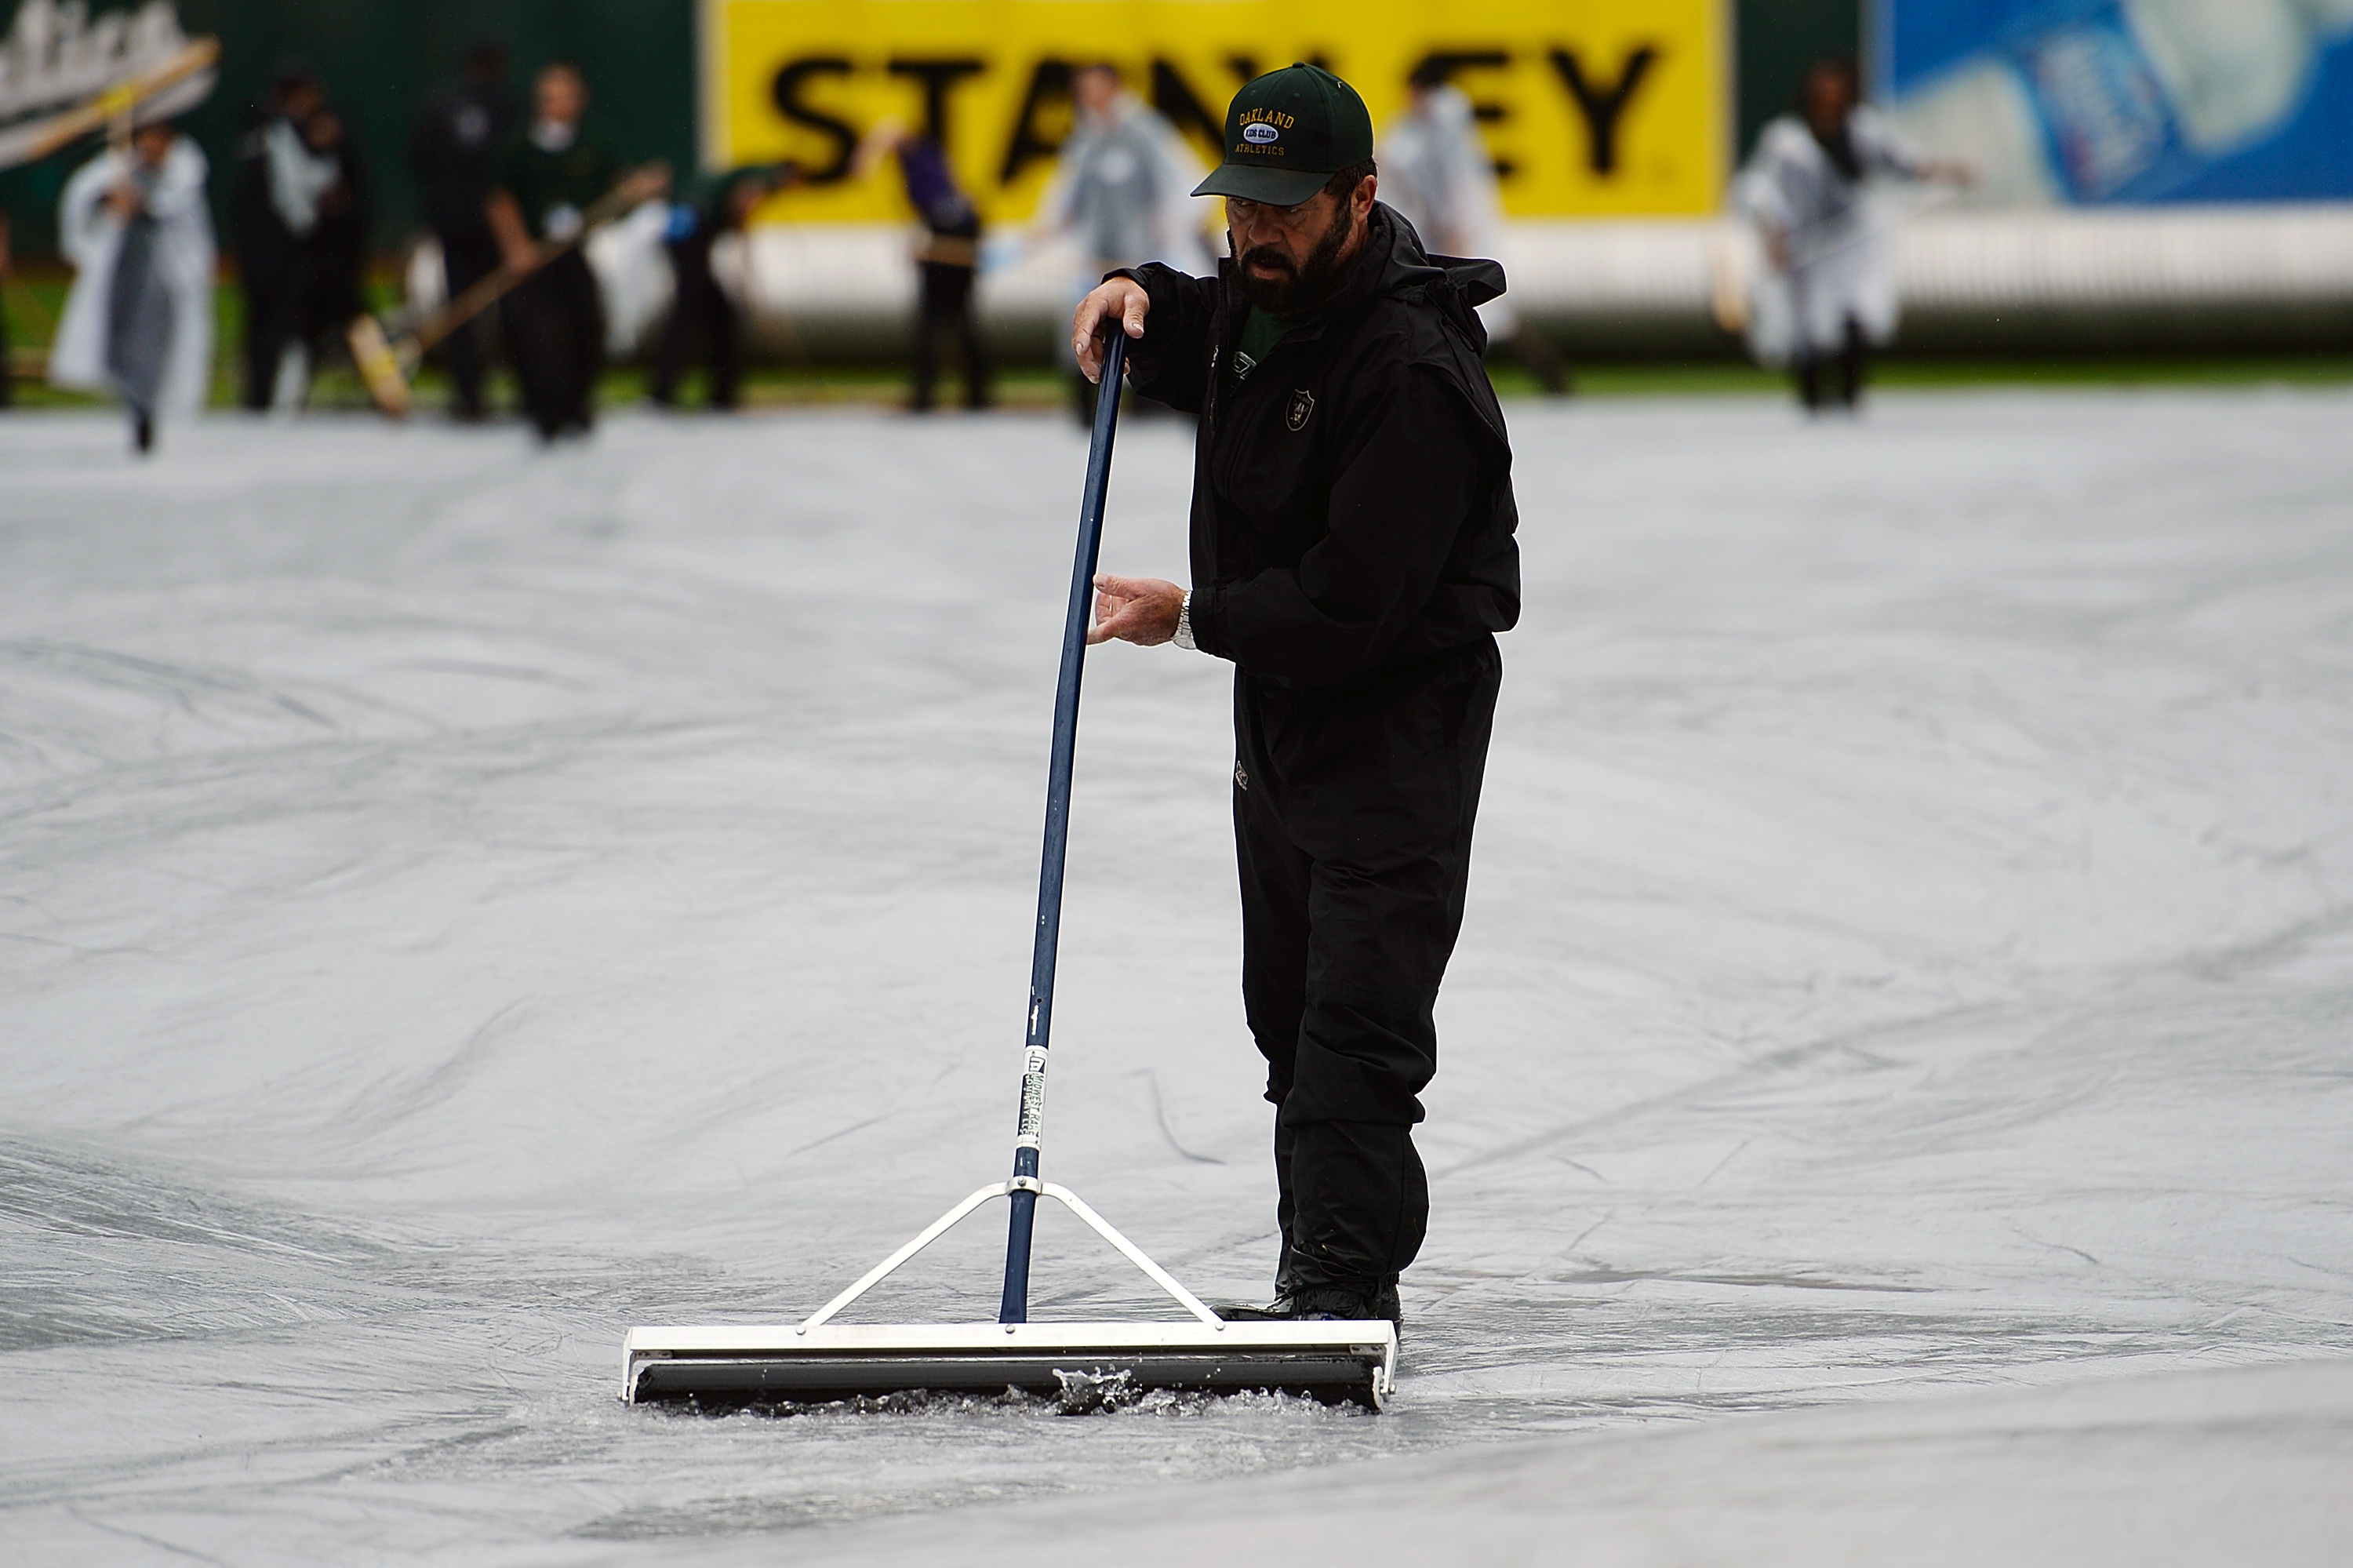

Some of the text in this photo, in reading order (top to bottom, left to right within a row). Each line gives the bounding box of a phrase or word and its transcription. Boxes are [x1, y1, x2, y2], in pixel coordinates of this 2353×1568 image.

[770, 55, 1661, 182] STANEY
[1239, 107, 1294, 129] OAKLAND
[1257, 129, 1277, 139] CLUB
[1235, 144, 1285, 156] ATHLETICS
[1031, 1074, 1044, 1111] MIDWEST
